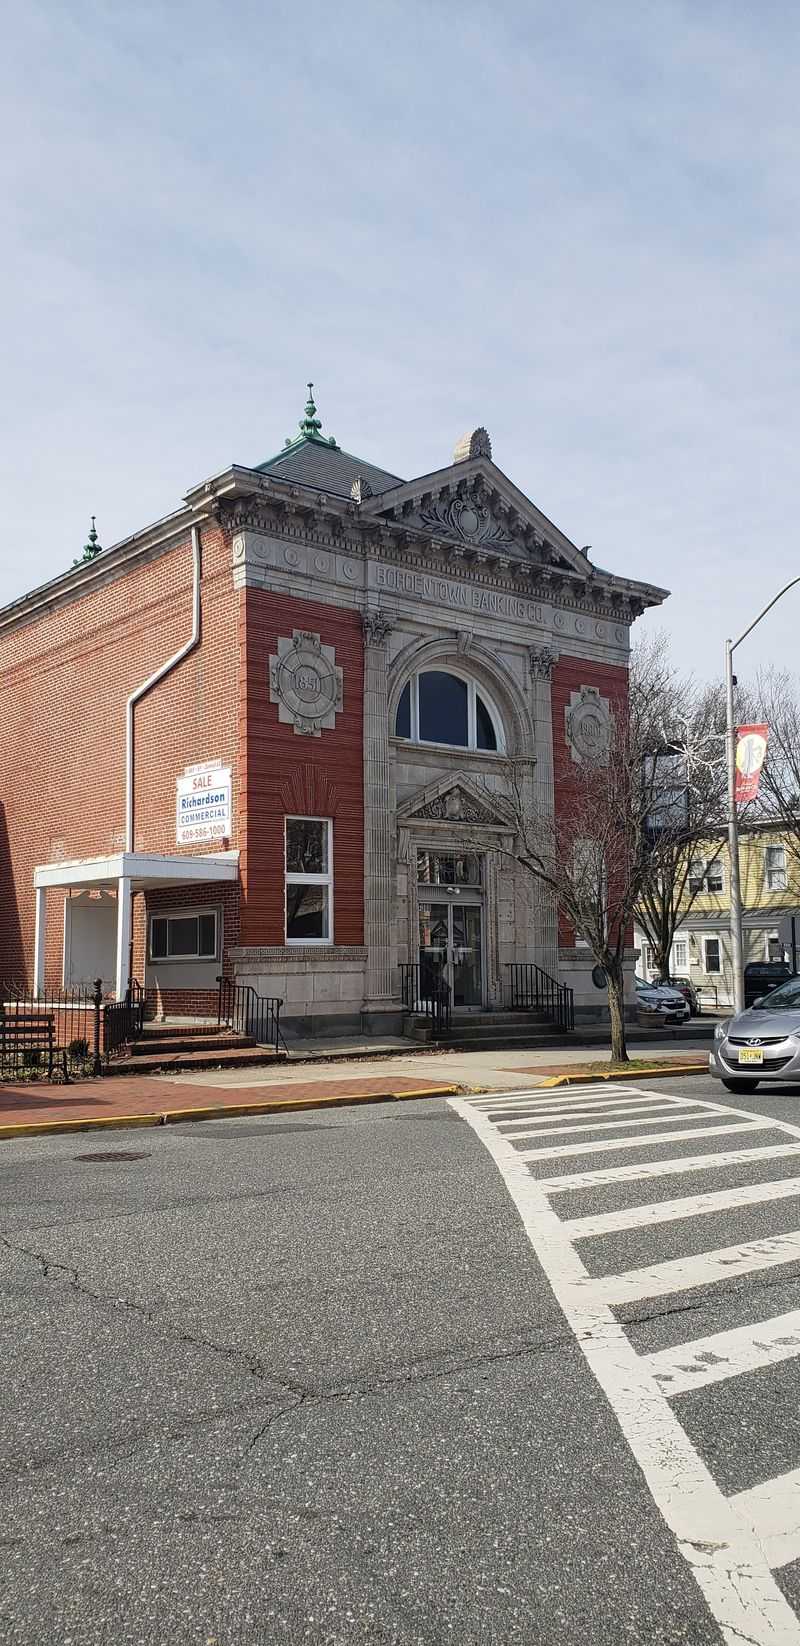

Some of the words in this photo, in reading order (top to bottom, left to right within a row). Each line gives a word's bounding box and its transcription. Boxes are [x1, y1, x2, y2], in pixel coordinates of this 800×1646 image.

[376, 568, 467, 604] BORDENTOWN
[472, 589, 526, 618] BANKING
[295, 675, 320, 691] 1851
[192, 775, 212, 790] SALE
[181, 793, 225, 809] Richardson
[181, 808, 226, 824] COMMERCIAL
[181, 824, 226, 840] 609-586-1000
